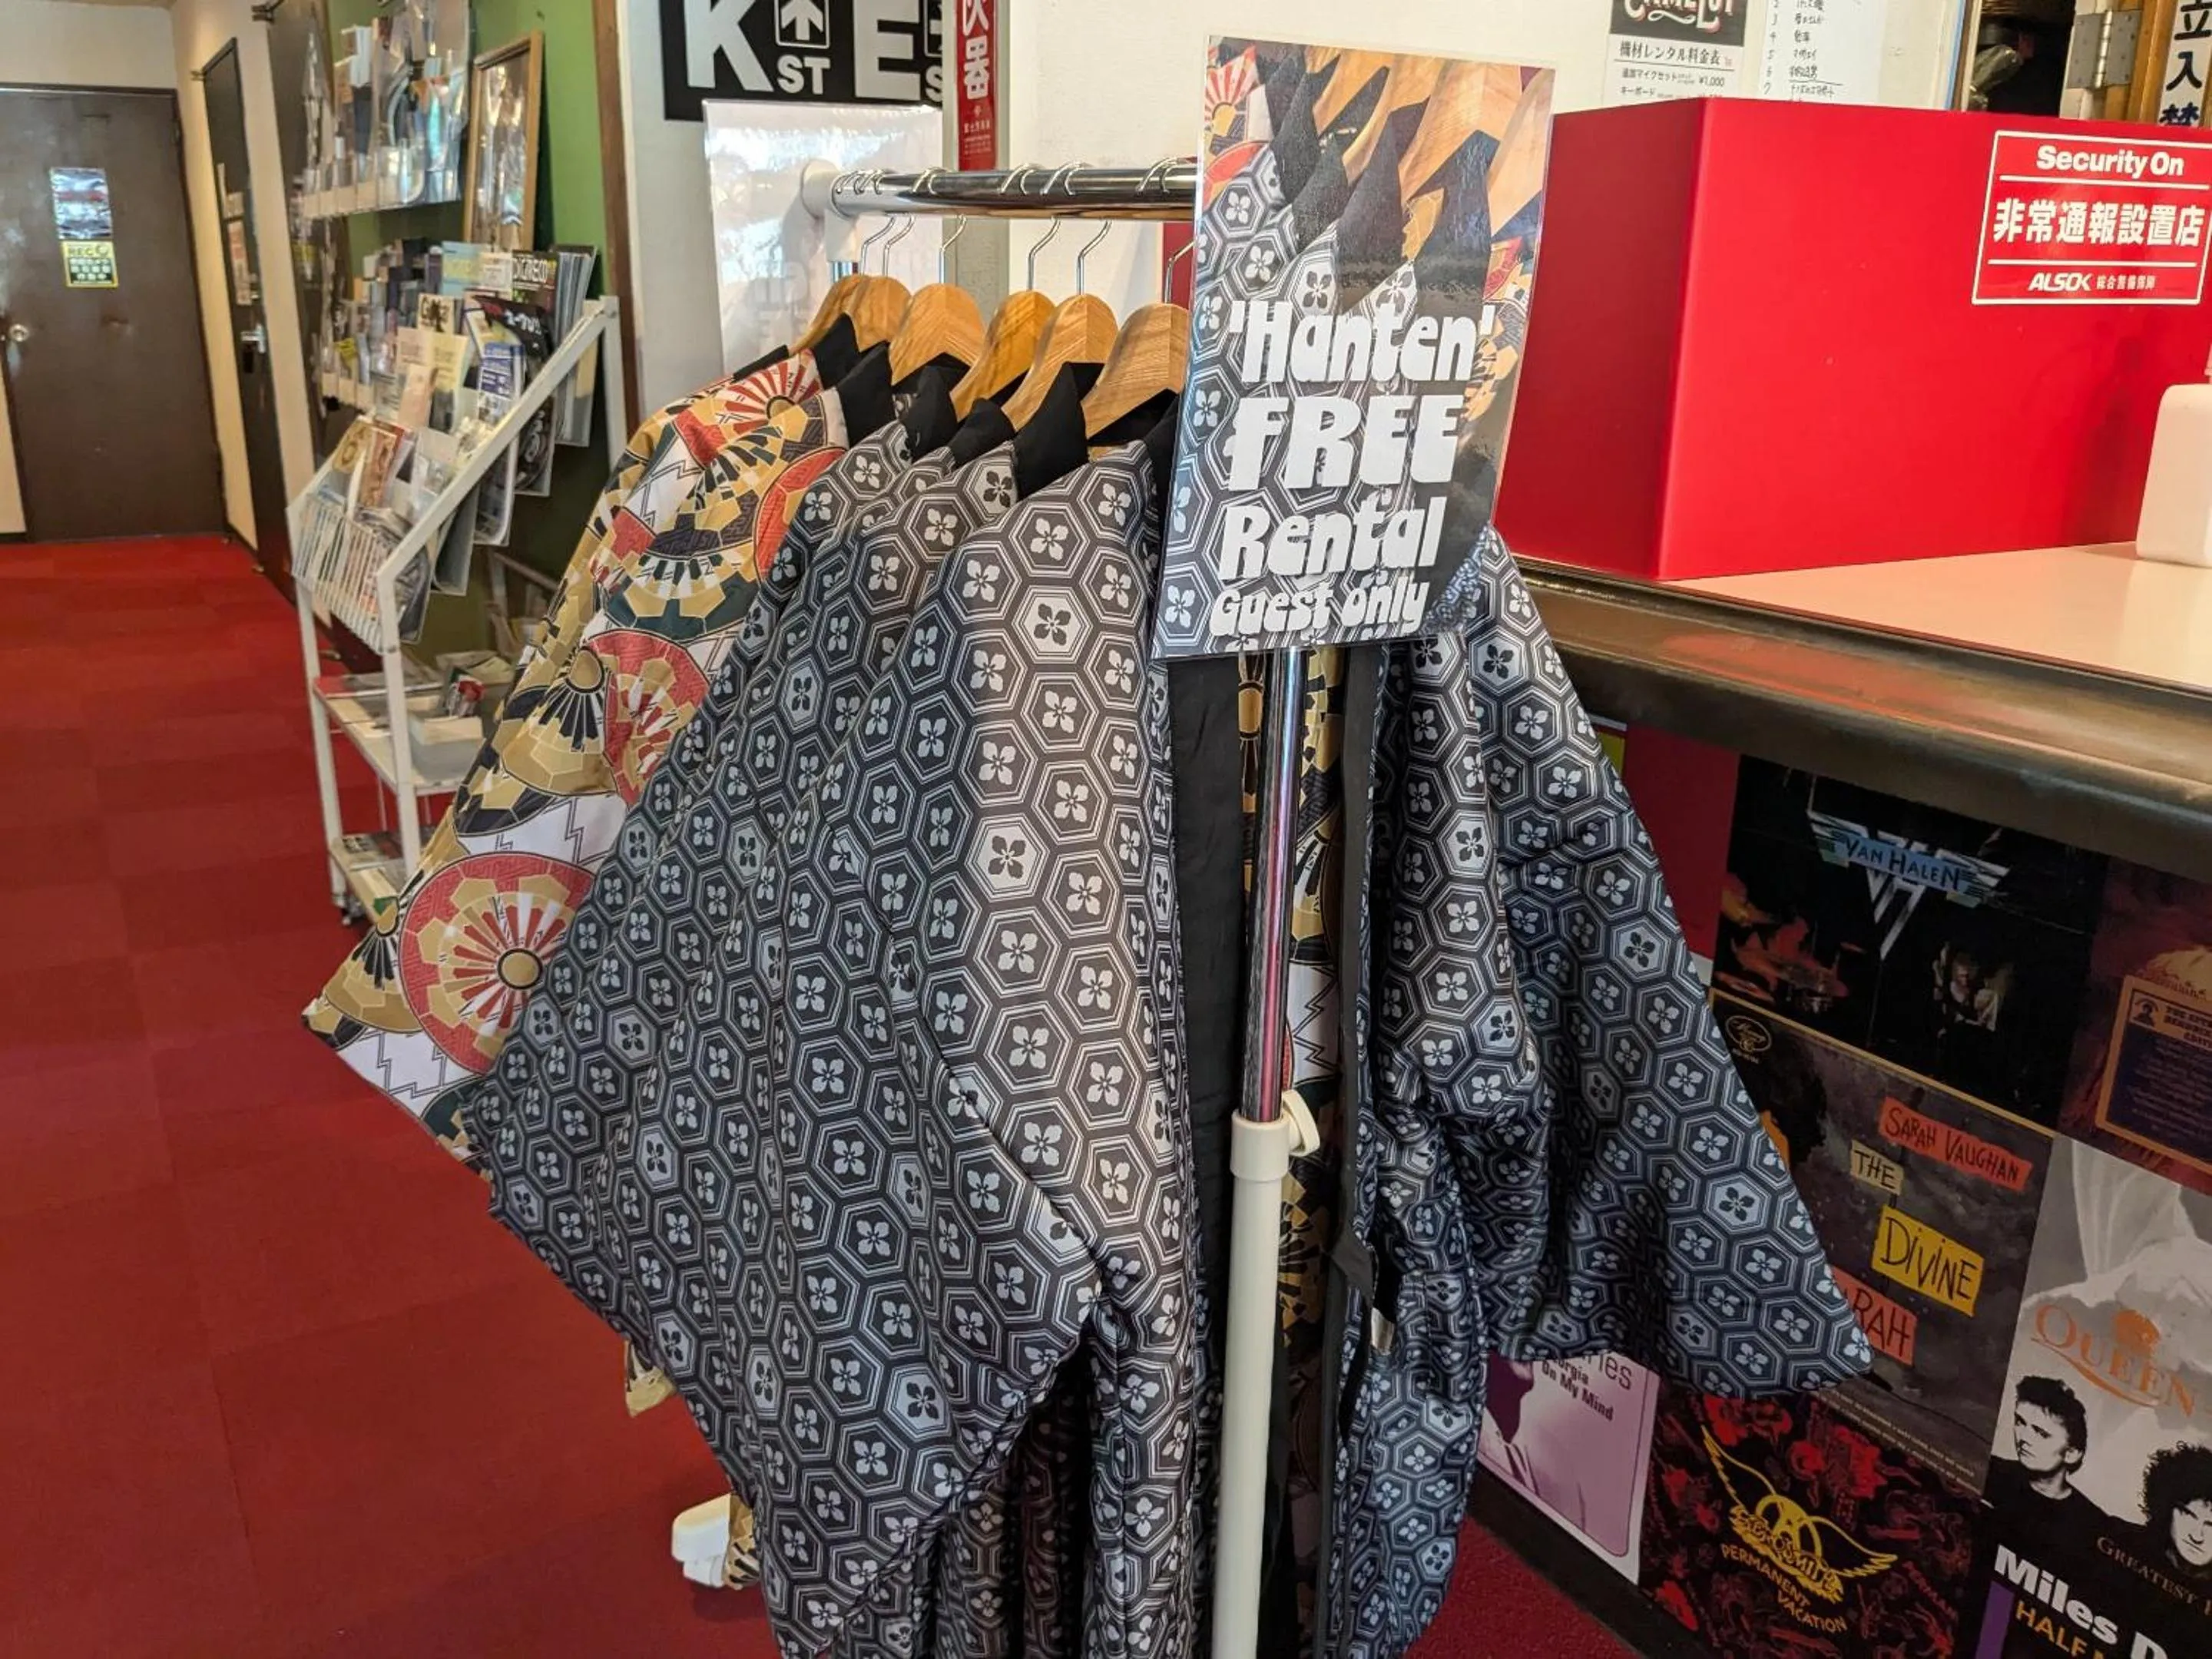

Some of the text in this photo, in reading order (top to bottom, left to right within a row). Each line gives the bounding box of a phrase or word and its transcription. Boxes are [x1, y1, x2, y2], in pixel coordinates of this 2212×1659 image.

[777, 55, 831, 95] ST
[2036, 144, 2184, 179] Security On
[1992, 197, 2206, 247] 非常通報設置店
[2027, 272, 2093, 292] ALSOK
[1229, 300, 1495, 384] 'Hanten'
[1224, 393, 1465, 492] FREE
[1218, 495, 1447, 581] Rental
[1209, 575, 1430, 637] Guest only
[1846, 836, 1959, 890] VAN HALEN
[1854, 1149, 1896, 1190] THE
[1885, 1107, 2019, 1186] SARAH VAUGHAN
[1844, 1286, 1910, 1357] RAH
[2032, 1304, 2195, 1418] QUEEN
[1560, 1373, 1579, 1399] My
[1582, 1387, 1614, 1422] Mind
[1720, 1542, 1811, 1608] PERMANENT
[1994, 1544, 2118, 1645] Miles
[2096, 1535, 2197, 1604] GREATEST
[1777, 1588, 1848, 1634] VACATION
[2015, 1599, 2088, 1657] HALF
